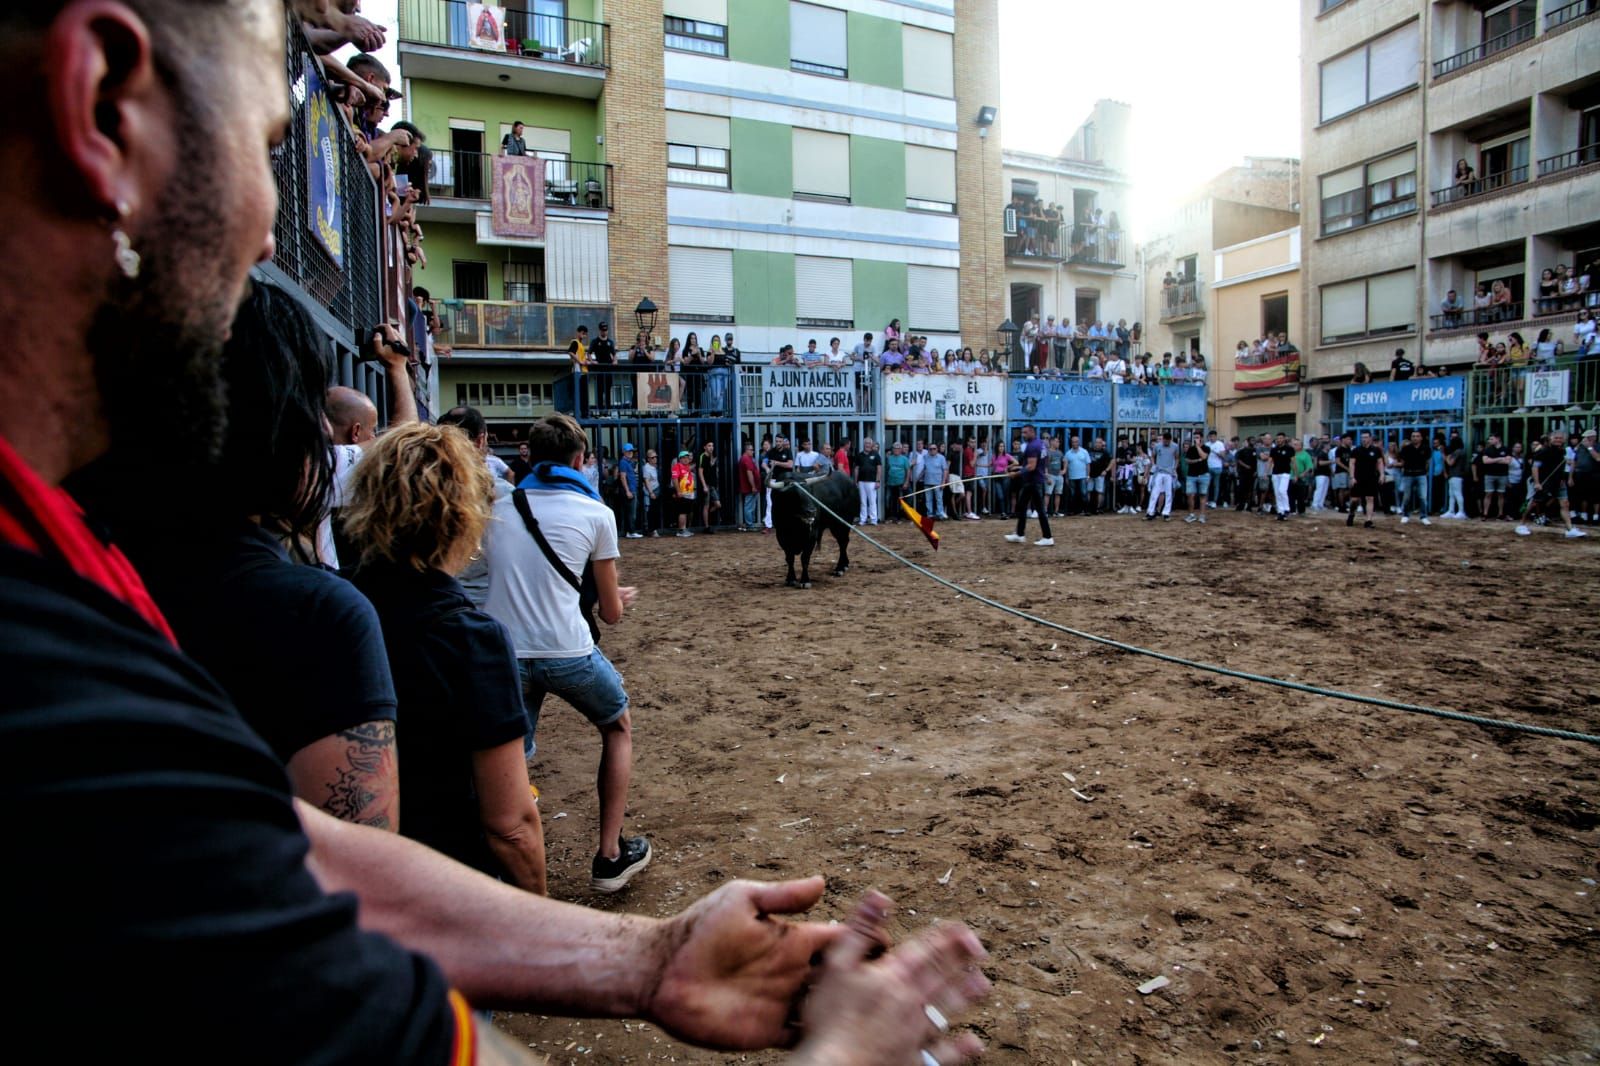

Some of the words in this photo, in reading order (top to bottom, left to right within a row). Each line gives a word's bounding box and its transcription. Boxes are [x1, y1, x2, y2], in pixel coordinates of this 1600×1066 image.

[769, 370, 849, 388] AJUNTAMENT
[967, 381, 980, 394] EL
[782, 391, 854, 408] ALMASSORA
[894, 389, 933, 405] PENYA
[1353, 391, 1388, 405] PENYA
[952, 403, 995, 417] TRASTO
